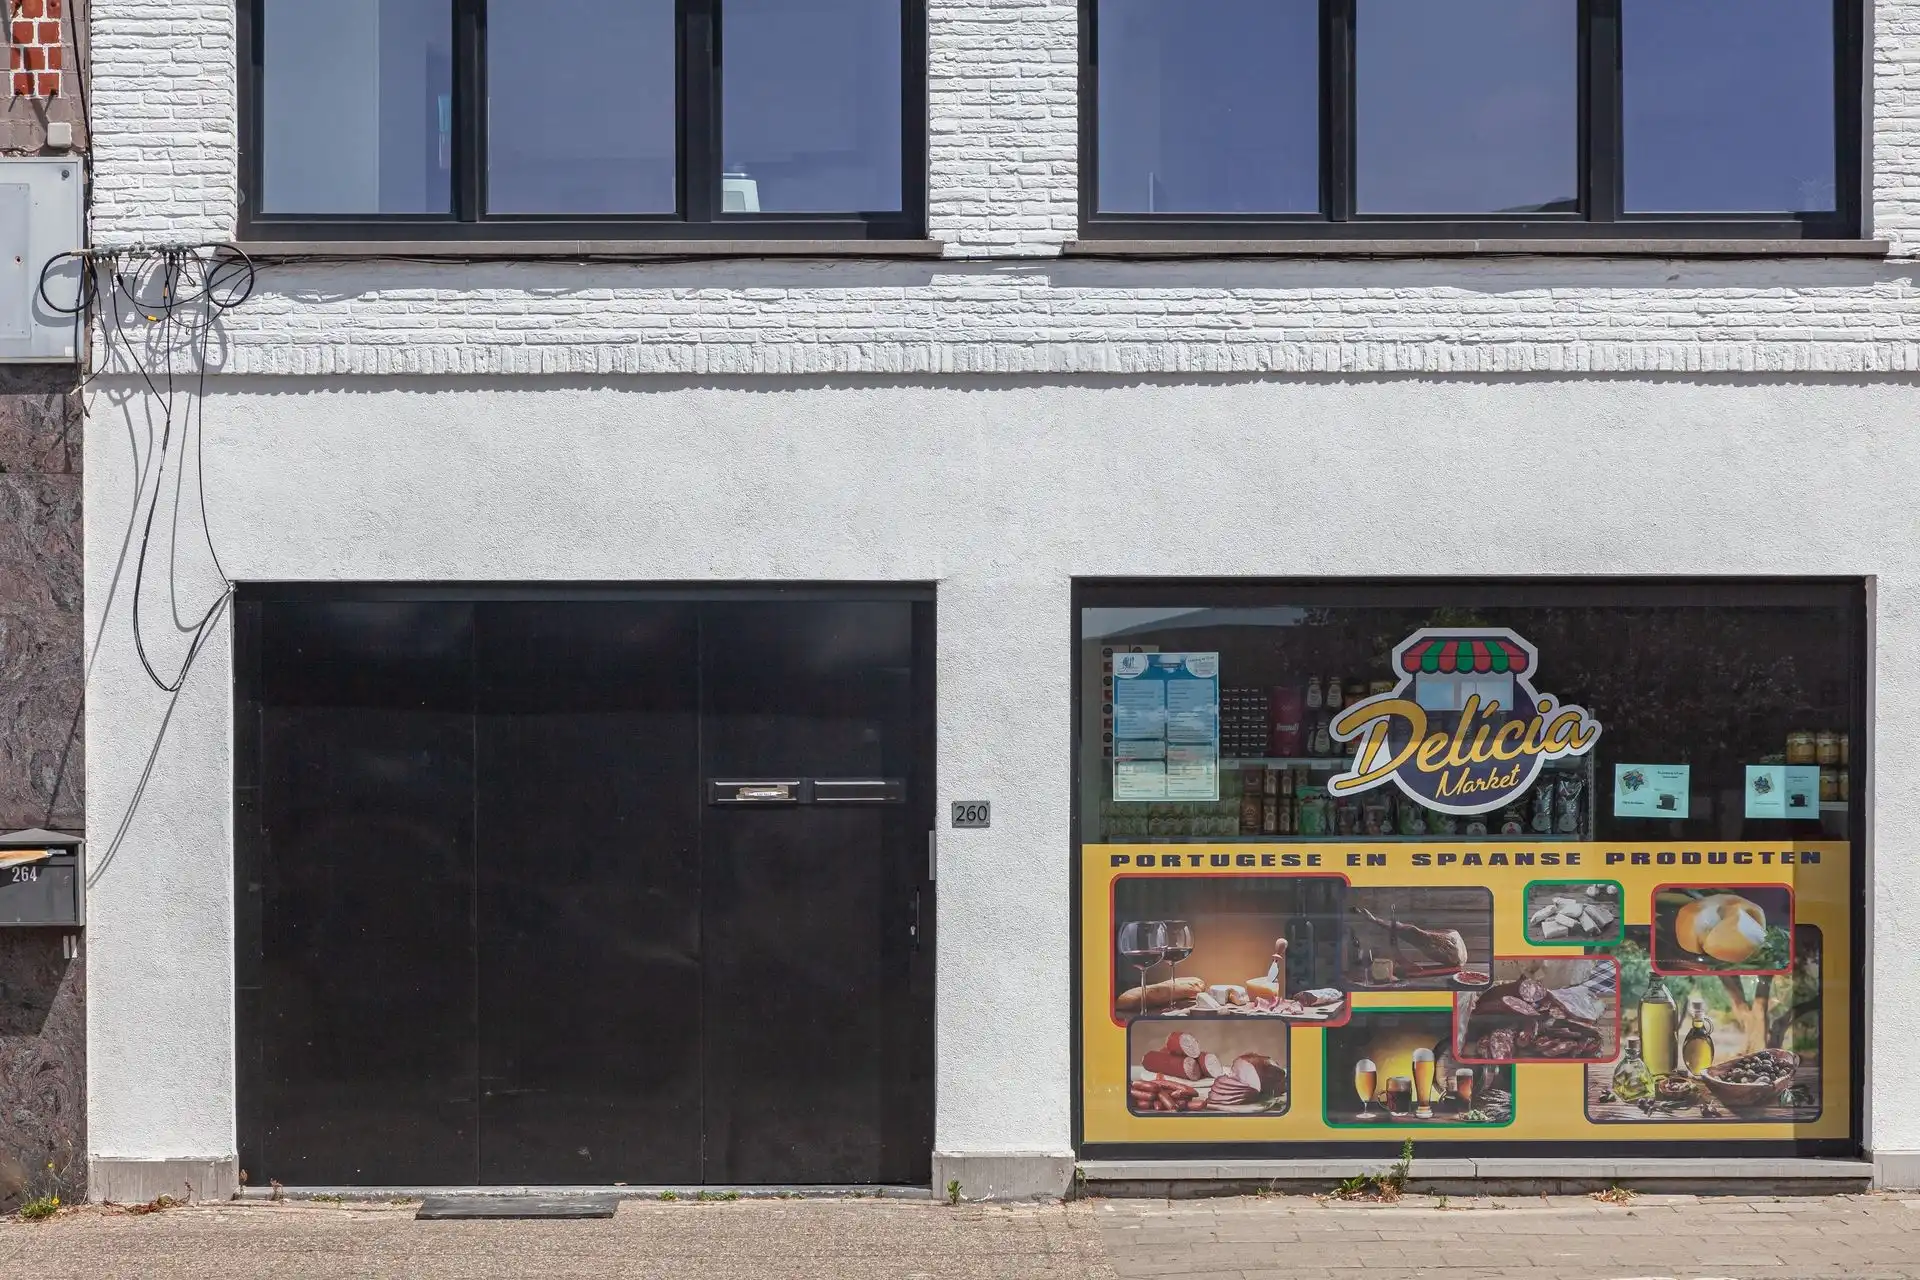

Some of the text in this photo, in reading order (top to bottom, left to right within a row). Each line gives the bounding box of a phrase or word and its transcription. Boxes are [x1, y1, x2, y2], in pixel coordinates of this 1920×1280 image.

[1435, 762, 1521, 799] Market
[956, 805, 988, 822] 260
[1110, 851, 1821, 868] PORTUGESE EN SPAANSE PRODUCTEN
[11, 866, 38, 883] 264
